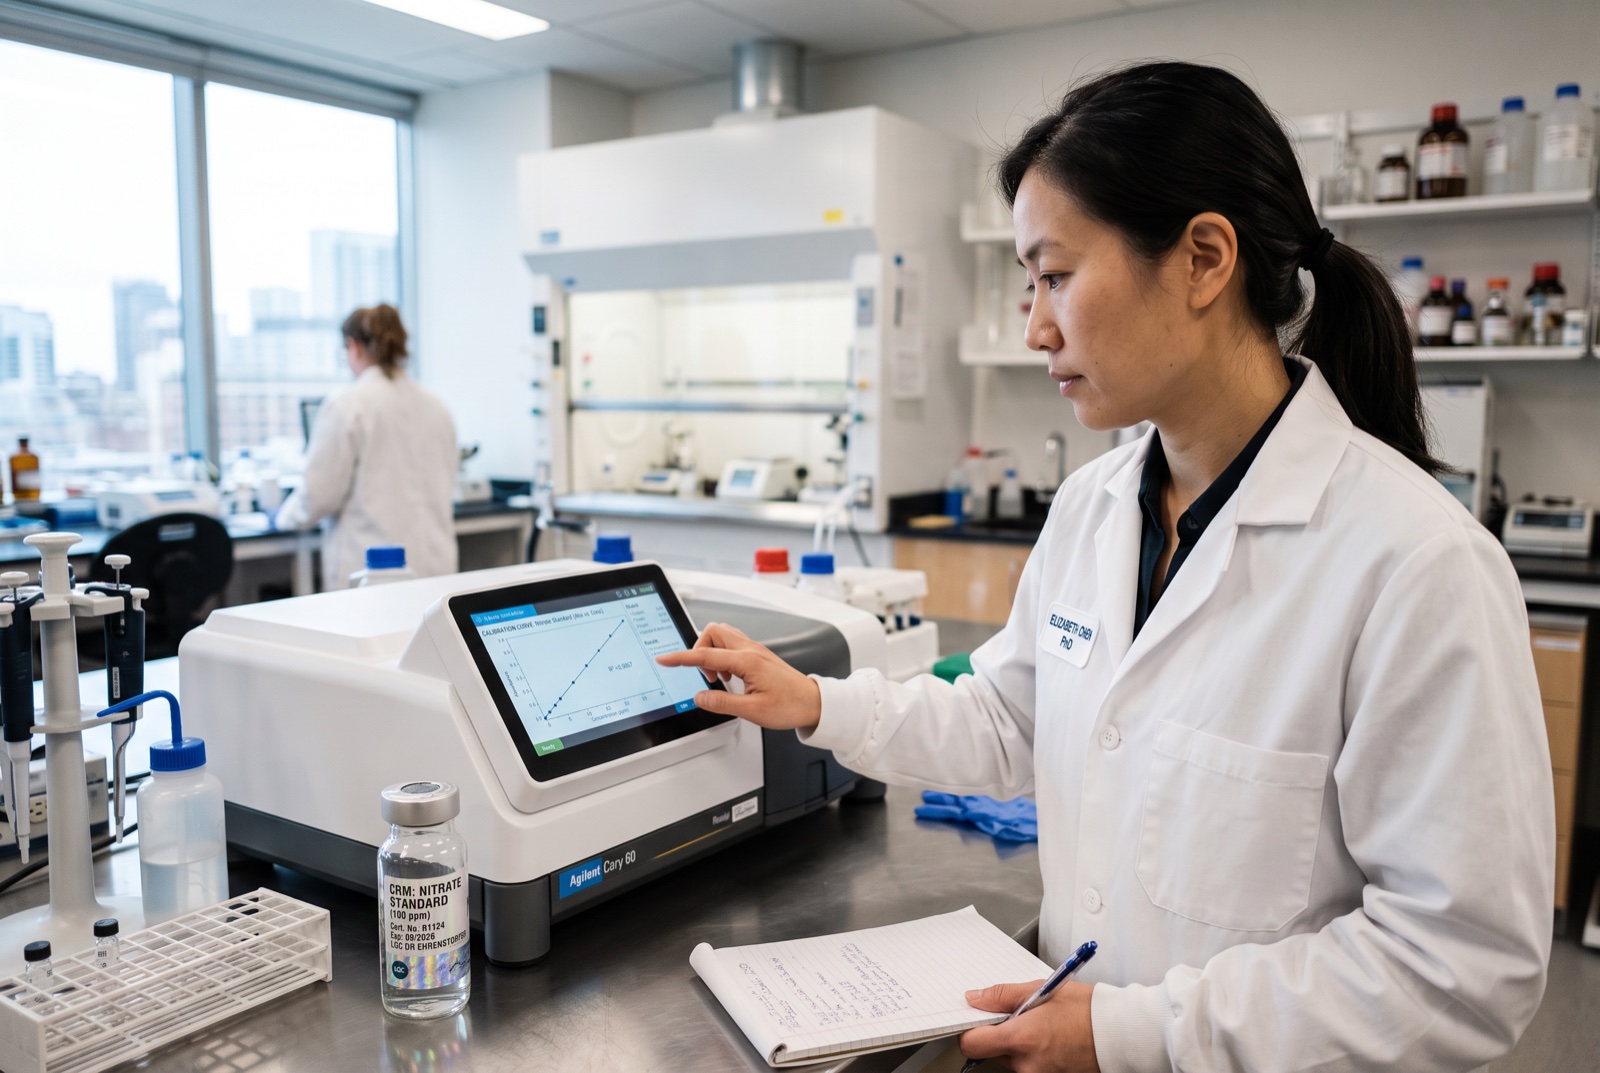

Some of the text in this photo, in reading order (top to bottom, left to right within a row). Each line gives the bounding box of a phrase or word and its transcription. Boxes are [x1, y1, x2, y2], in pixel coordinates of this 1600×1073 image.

[481, 624, 517, 637] CALIBRATION
[1049, 613, 1093, 641] ELIZABETH CHEN
[569, 850, 636, 888] Agilent Cary 60
[389, 876, 462, 897] CRM: NITRATE
[390, 894, 448, 910] STANDARD
[390, 909, 431, 922] (100 ppm)
[390, 921, 405, 932] Cert.
[422, 921, 445, 932] R1124
[405, 932, 436, 942] 09/2026
[390, 940, 403, 950] LGC
[405, 942, 415, 951] DR
